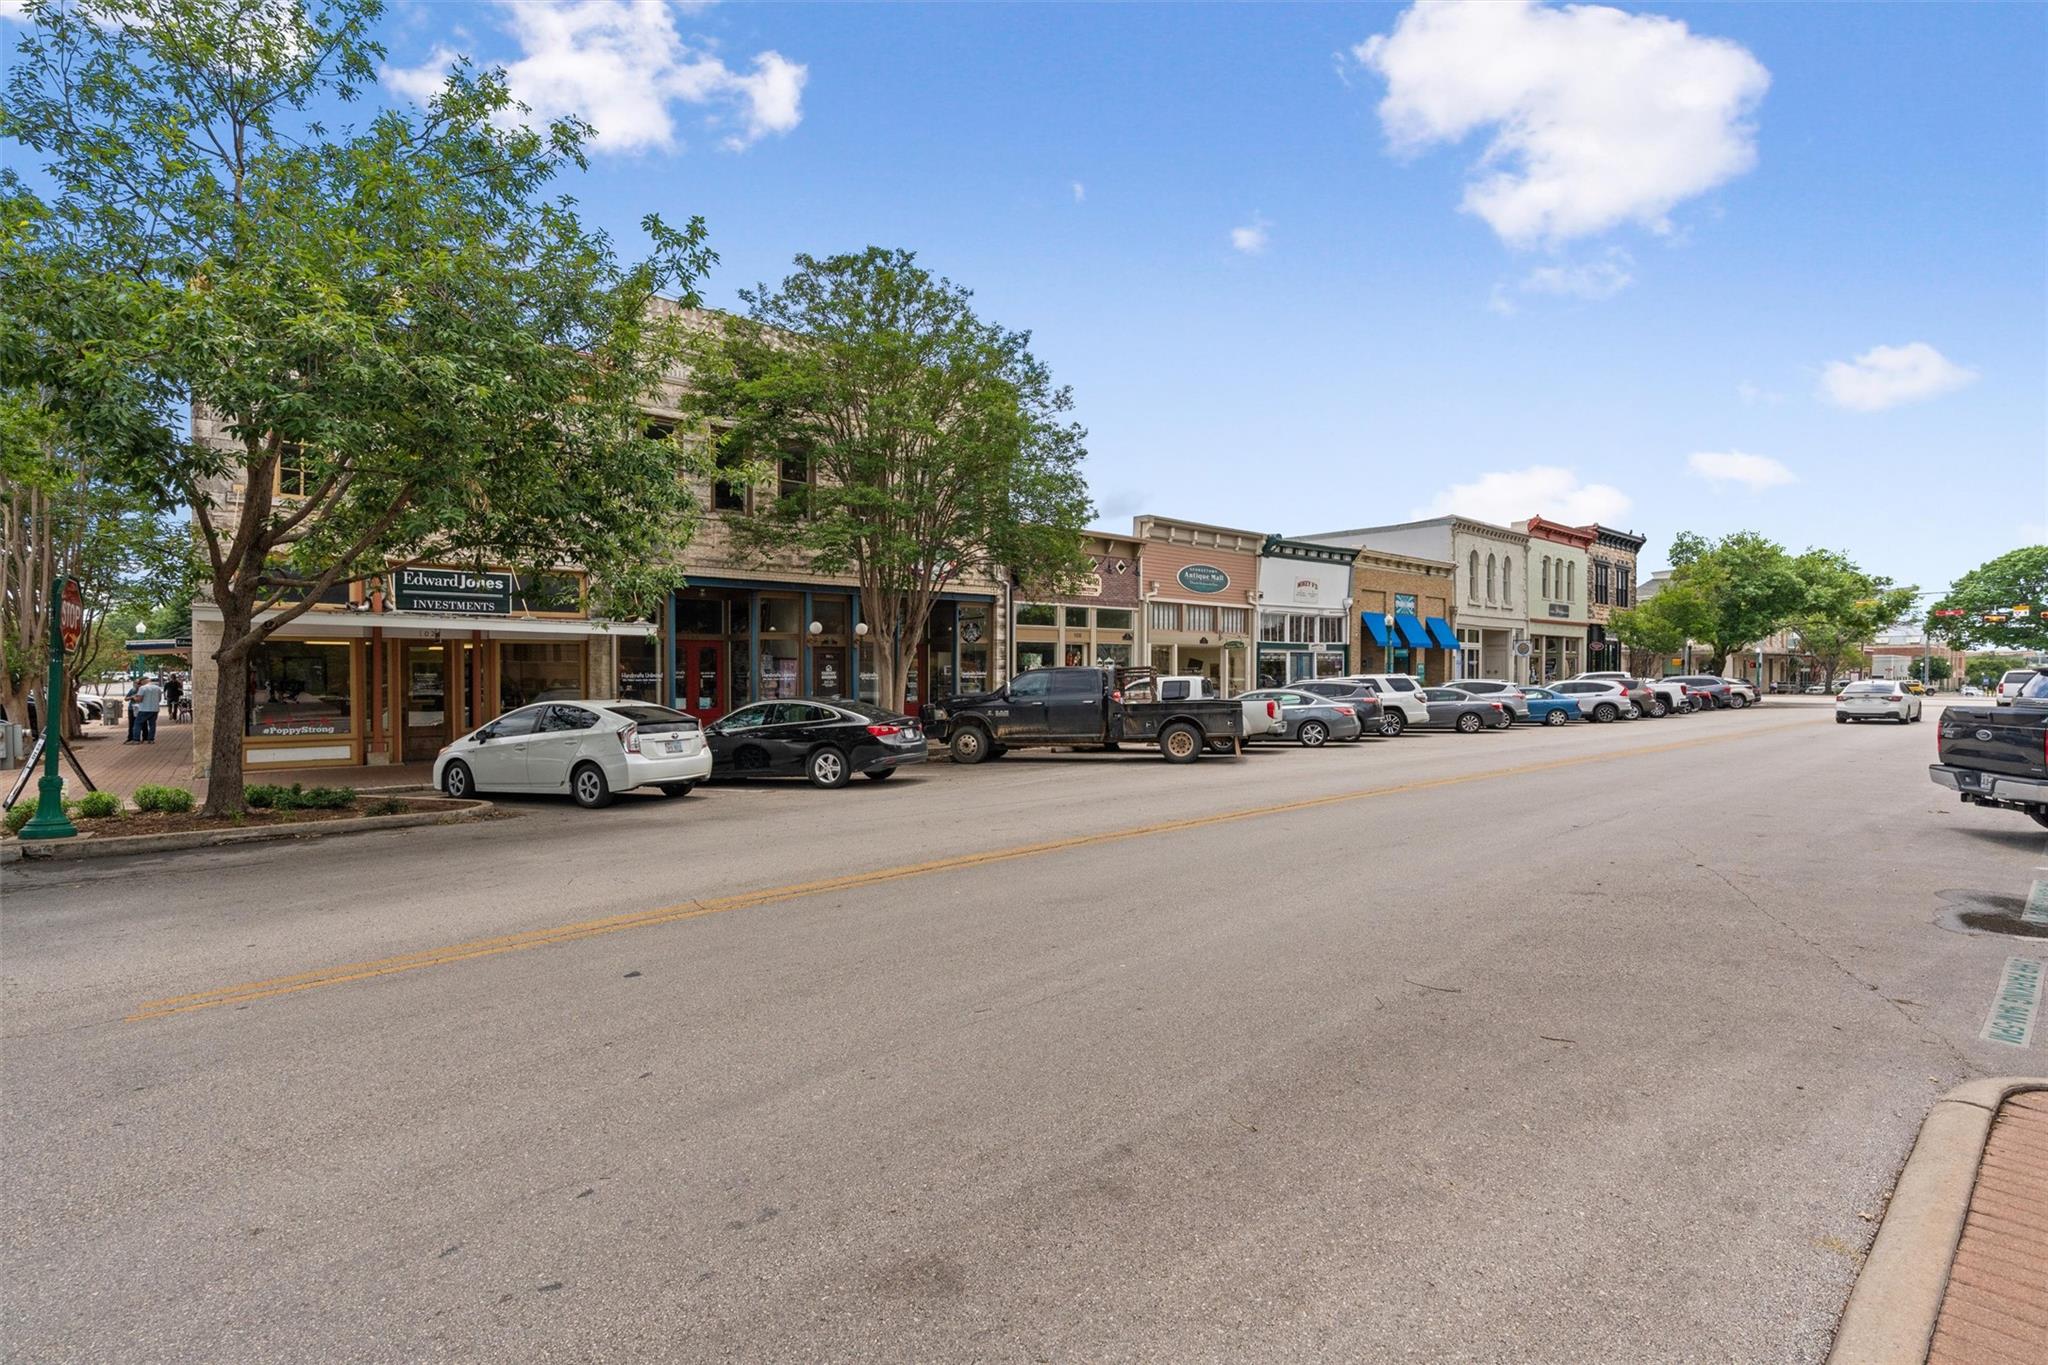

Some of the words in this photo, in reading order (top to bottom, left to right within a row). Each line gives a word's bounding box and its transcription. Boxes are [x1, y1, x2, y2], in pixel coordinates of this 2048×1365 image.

[403, 571, 458, 587] Edward
[459, 574, 504, 590] Jones
[1184, 571, 1210, 581] Antique
[1211, 573, 1225, 581] Mall
[413, 599, 496, 612] INVESTMENTS
[61, 600, 81, 630] STOP
[263, 726, 335, 736] #PoppyStrong
